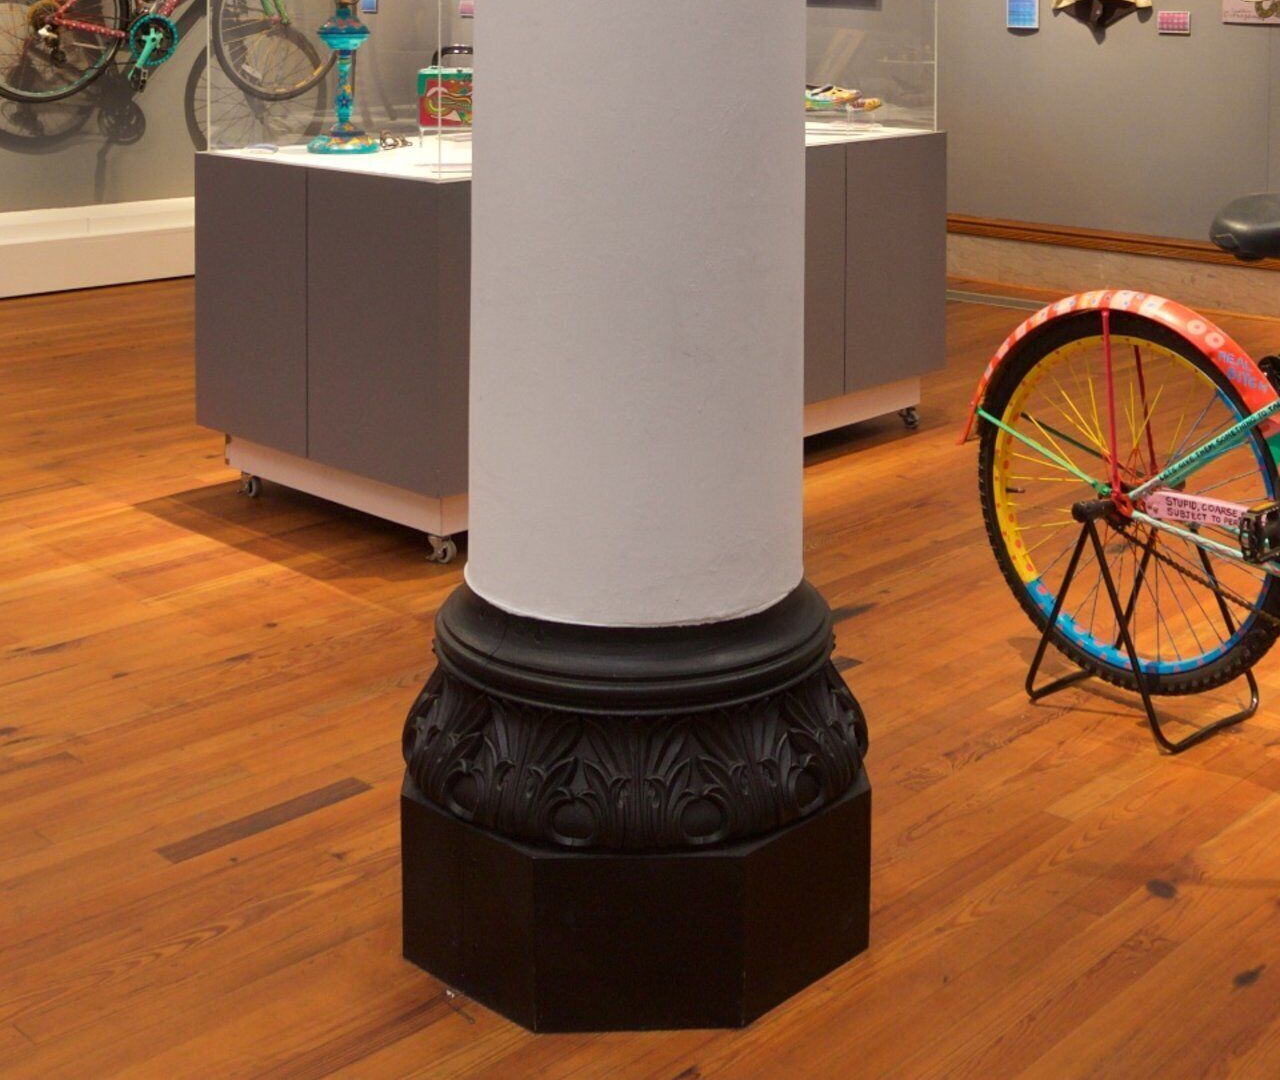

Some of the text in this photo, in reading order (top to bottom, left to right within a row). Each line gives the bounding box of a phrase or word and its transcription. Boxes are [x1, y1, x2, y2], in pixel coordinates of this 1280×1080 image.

[1165, 496, 1201, 512] STUPID,
[1166, 507, 1207, 522] SUBJECT
[1211, 515, 1221, 523] TO
